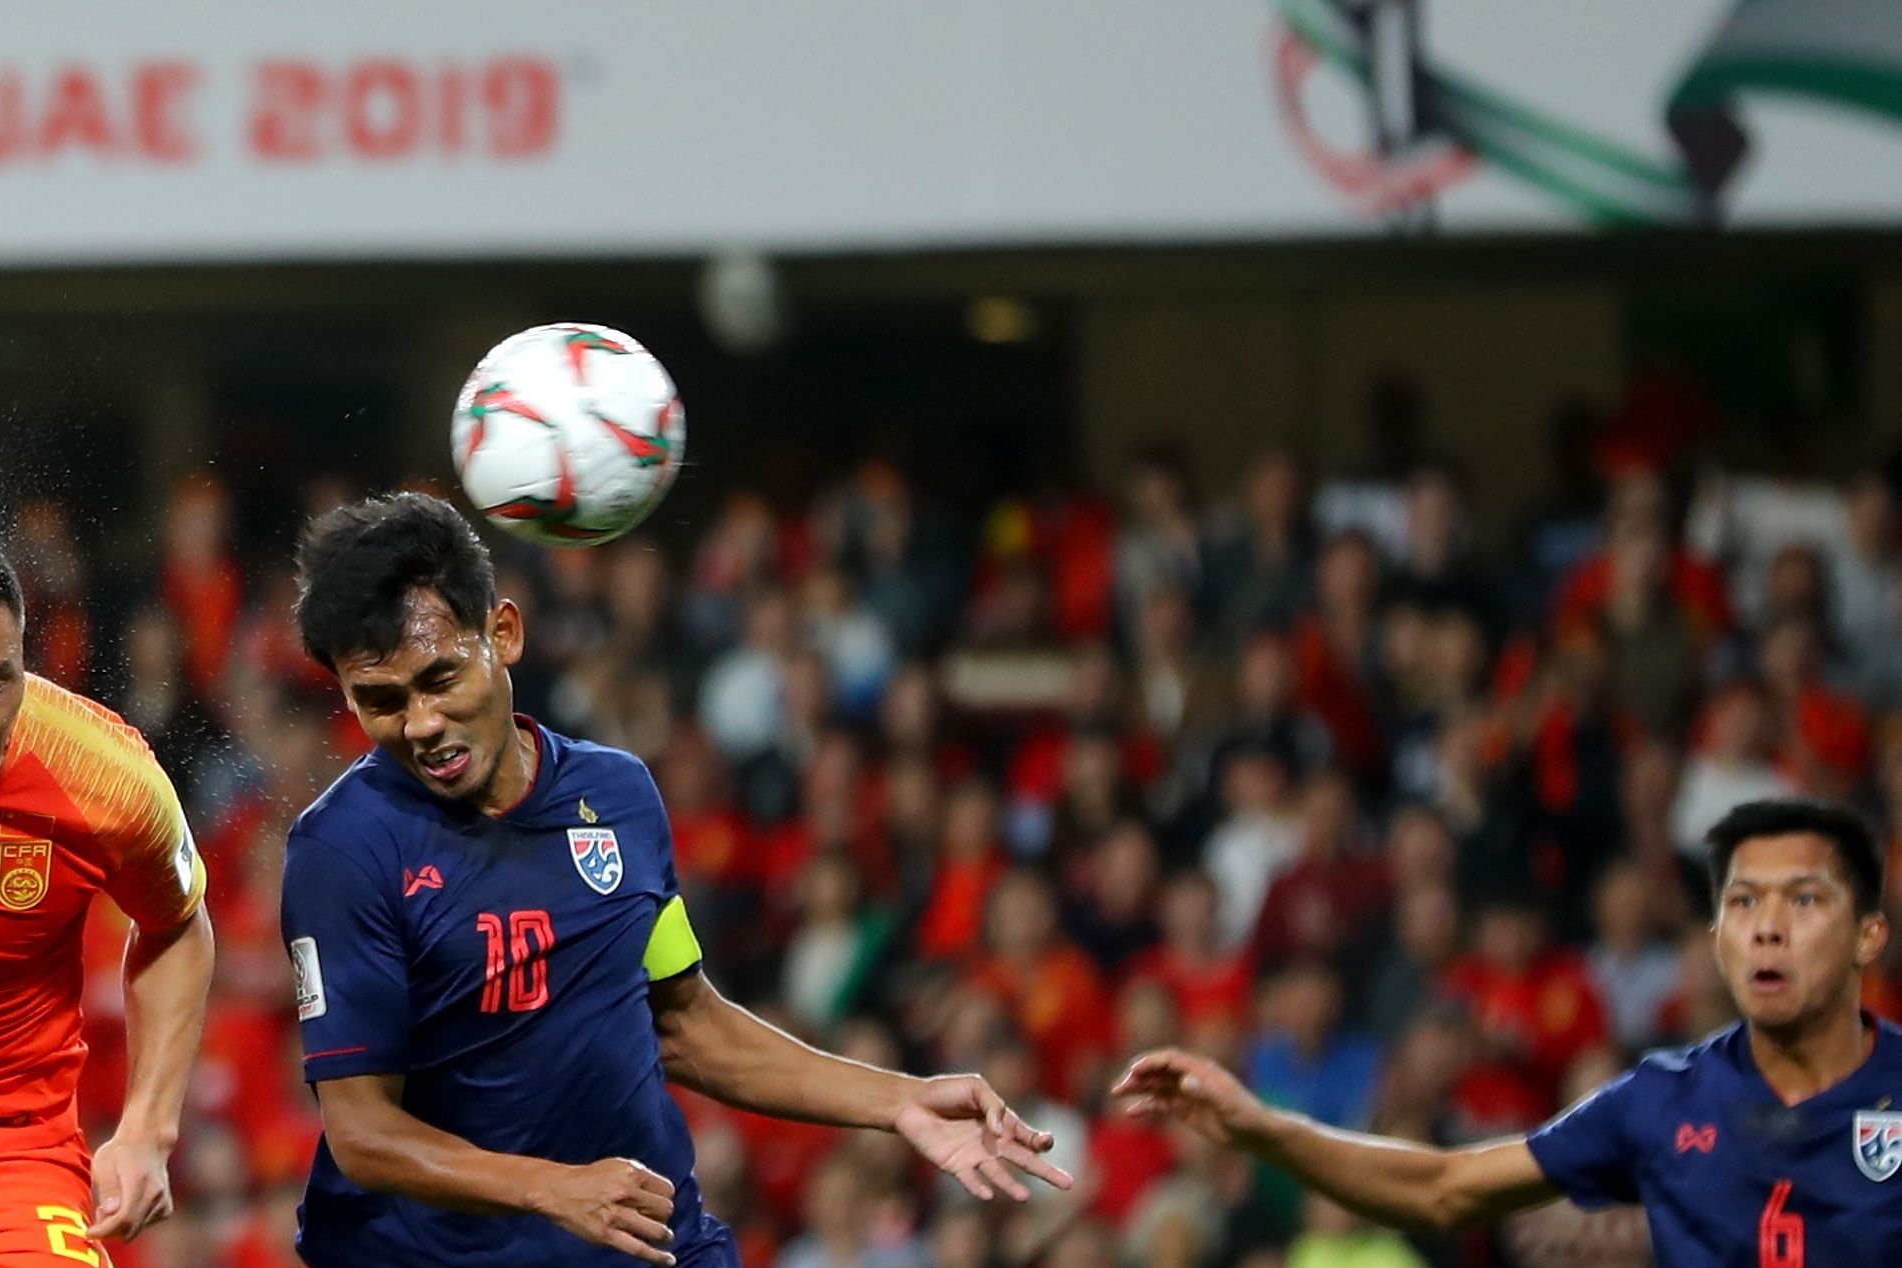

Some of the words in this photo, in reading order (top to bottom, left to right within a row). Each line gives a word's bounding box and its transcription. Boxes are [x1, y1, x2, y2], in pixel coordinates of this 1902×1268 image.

[246, 54, 564, 163] 2019
[3, 845, 47, 858] CFA
[477, 910, 555, 1013] 10
